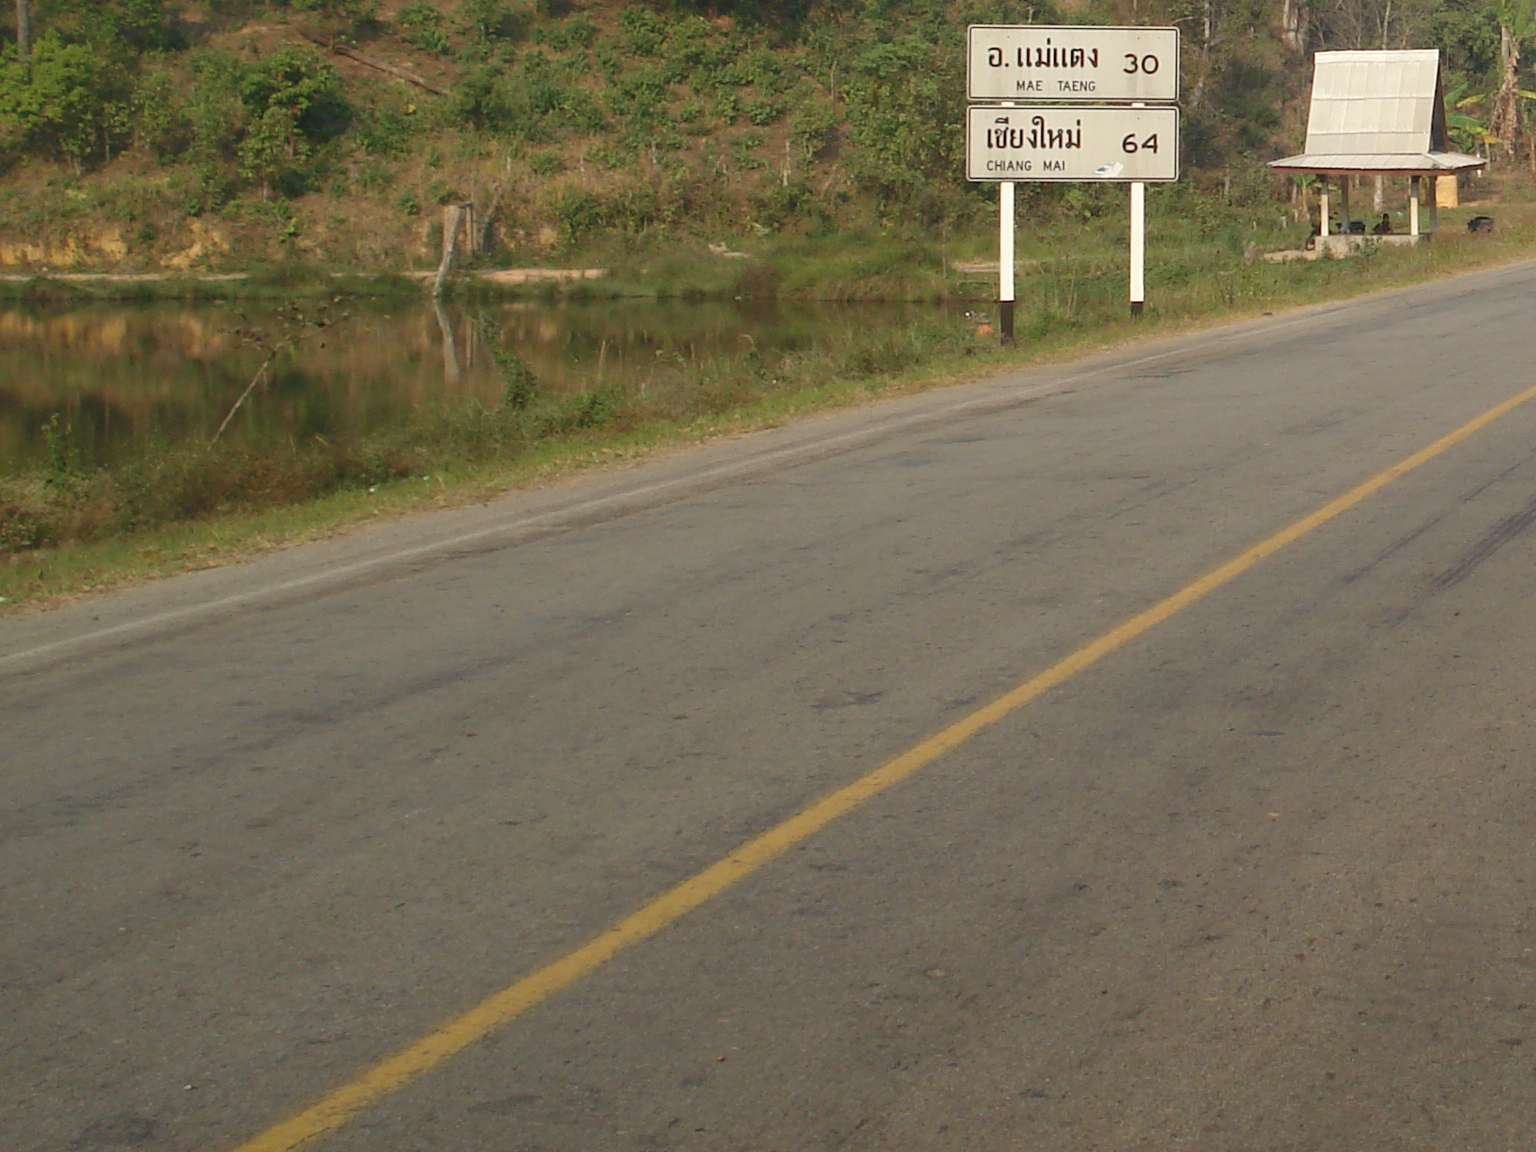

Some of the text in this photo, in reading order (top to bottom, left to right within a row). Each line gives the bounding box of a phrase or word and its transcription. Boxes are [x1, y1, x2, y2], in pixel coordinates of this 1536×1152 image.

[988, 38, 1159, 74] อ. แม่แตง 30
[1016, 80, 1096, 91] MAE TAENG
[987, 116, 1158, 154] เชียงใหม่ 64
[987, 160, 1065, 171] CHIANG MAI
